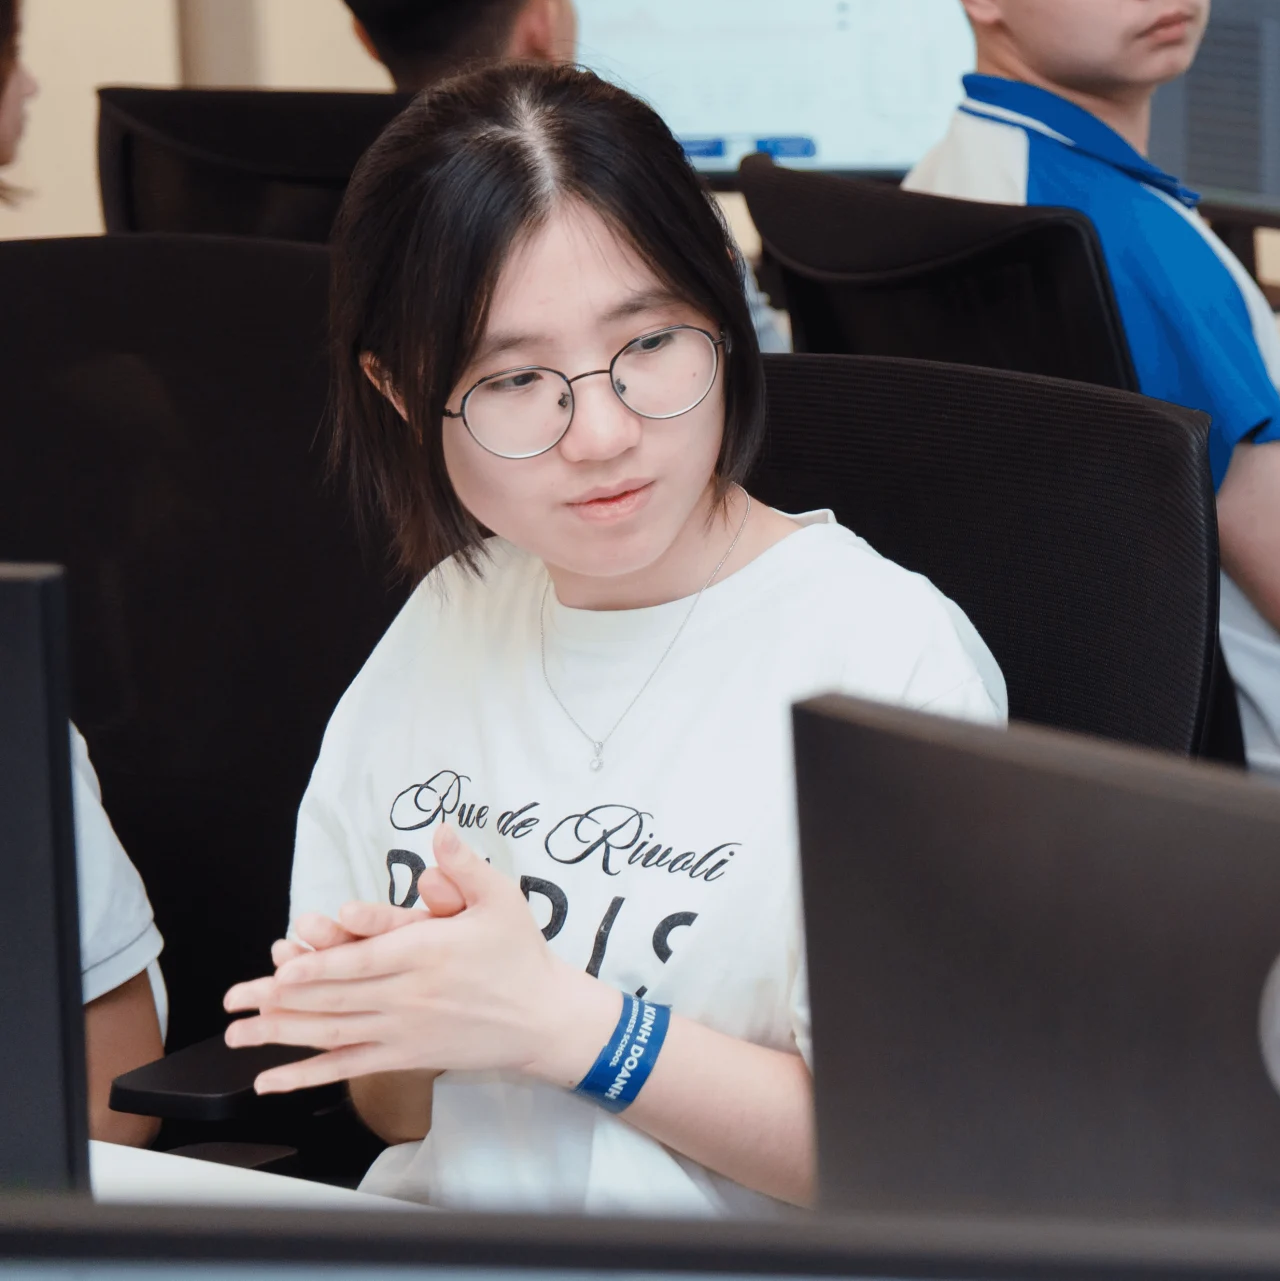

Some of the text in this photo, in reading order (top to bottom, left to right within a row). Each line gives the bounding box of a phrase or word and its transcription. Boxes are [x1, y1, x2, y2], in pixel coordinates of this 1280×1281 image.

[390, 770, 742, 882] Rue de Rivoli
[604, 1004, 657, 1100] KINH DOANH
[609, 1033, 630, 1067] SCHOOL
